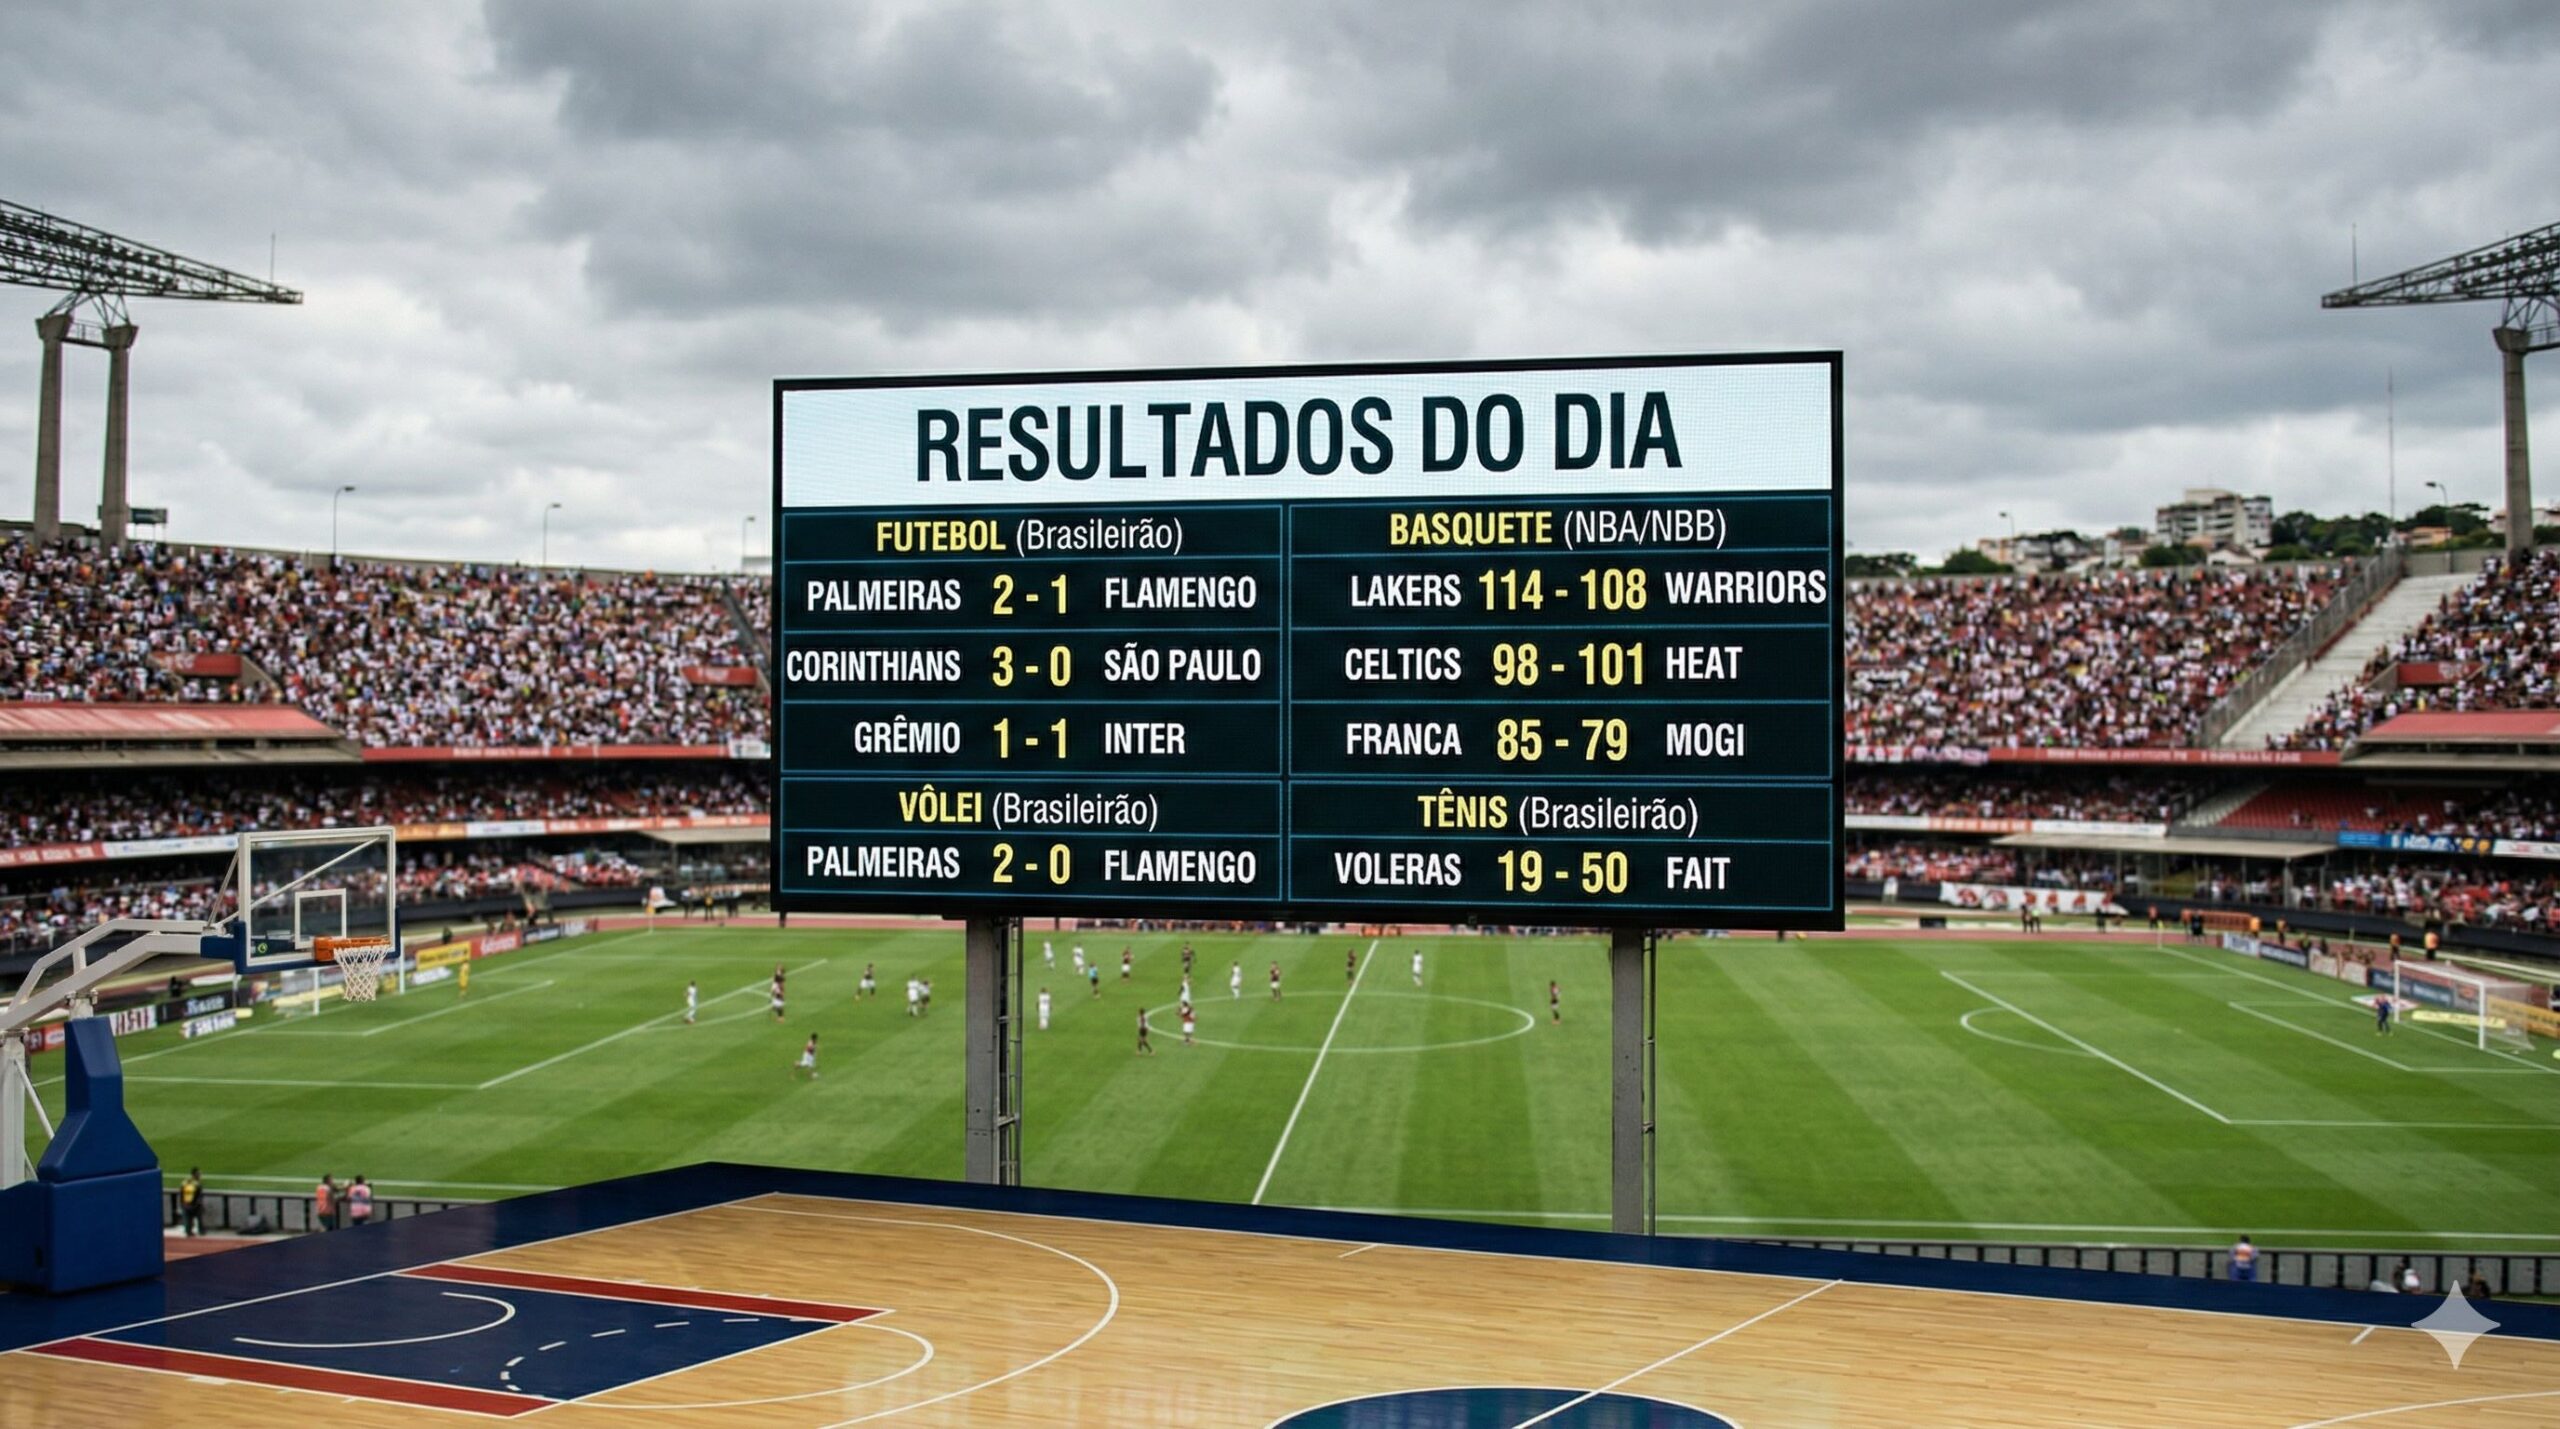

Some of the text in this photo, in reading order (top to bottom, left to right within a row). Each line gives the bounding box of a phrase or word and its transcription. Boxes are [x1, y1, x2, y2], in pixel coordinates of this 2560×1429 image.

[917, 391, 1682, 482] RESULTADOS DO DIA
[876, 517, 1183, 558] FUTEBOL (Brasileirão)
[1390, 508, 1727, 551] BASQUETE (NBA/NBB)
[807, 574, 1257, 615] PALMEIRAS 2 - 1 FLAMENGO
[1351, 568, 1827, 611] LAKERS 114 - 108 WARRIORS
[787, 642, 1262, 687] CORINTHIANS 3 - 0 SÃO PAULO
[1345, 642, 1743, 686] CELTICS 98 - 101 HEAT
[854, 715, 1186, 759] GRÊMIO 1 - 1 INTER
[1346, 719, 1744, 762] FRANCA 85 - 79 MOGI
[898, 784, 1158, 833] VÔLEI (Brasileirão)
[1418, 788, 1699, 839] TÊNIS (Brasileirão)
[807, 843, 1257, 885] PALMEIRAS 2 - 0 FLAMENGO
[1334, 850, 1731, 894] VOLERAS 19 - 50 FAIT
